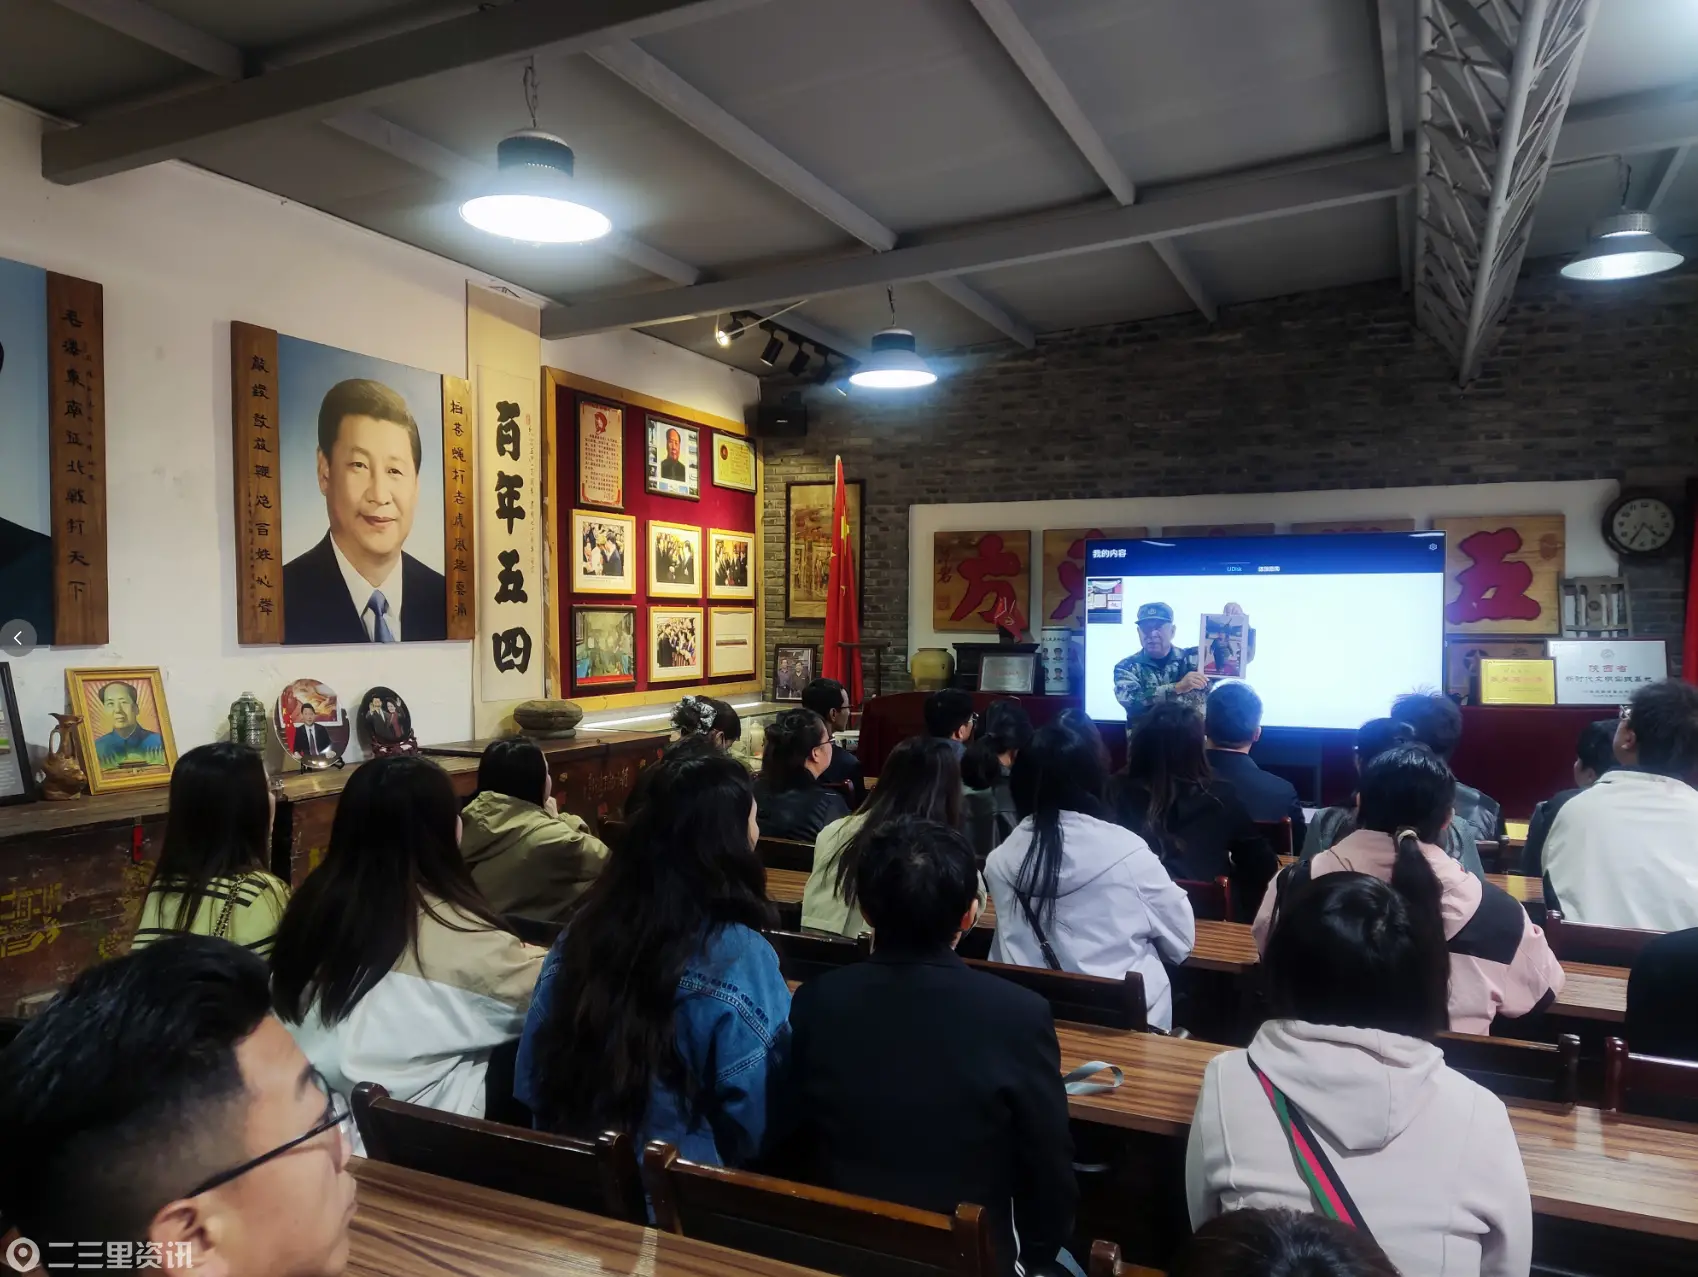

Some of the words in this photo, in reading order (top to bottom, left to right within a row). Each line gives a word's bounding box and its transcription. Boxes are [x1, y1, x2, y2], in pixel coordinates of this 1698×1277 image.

[492, 400, 532, 674] 百年五四
[1092, 548, 1127, 558] 我的内容
[1588, 664, 1628, 673] 陕西省
